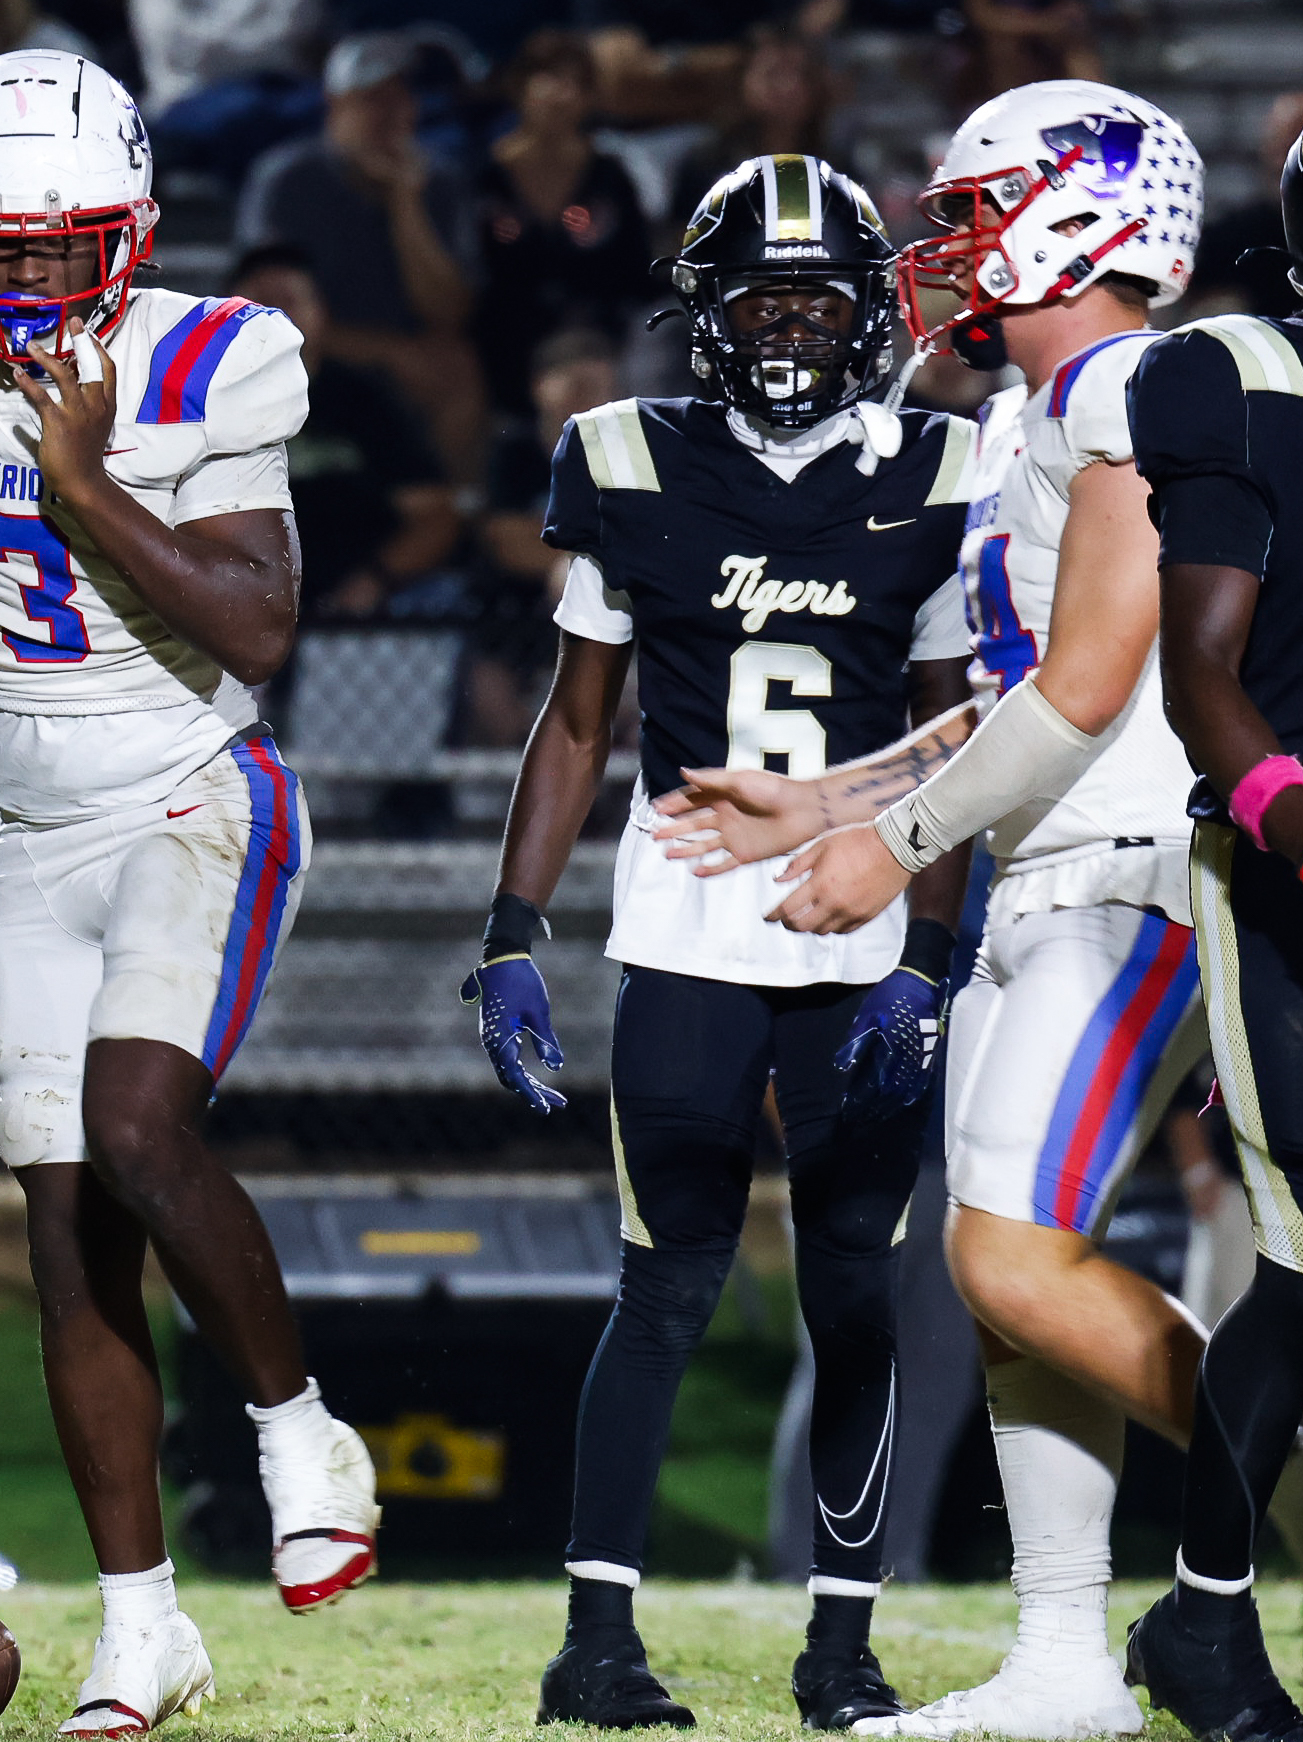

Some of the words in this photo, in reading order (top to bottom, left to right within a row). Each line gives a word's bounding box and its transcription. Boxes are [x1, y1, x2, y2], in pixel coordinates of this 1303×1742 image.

[764, 246, 824, 259] Riddell
[711, 554, 857, 633] Tigers
[726, 640, 832, 781] 6
